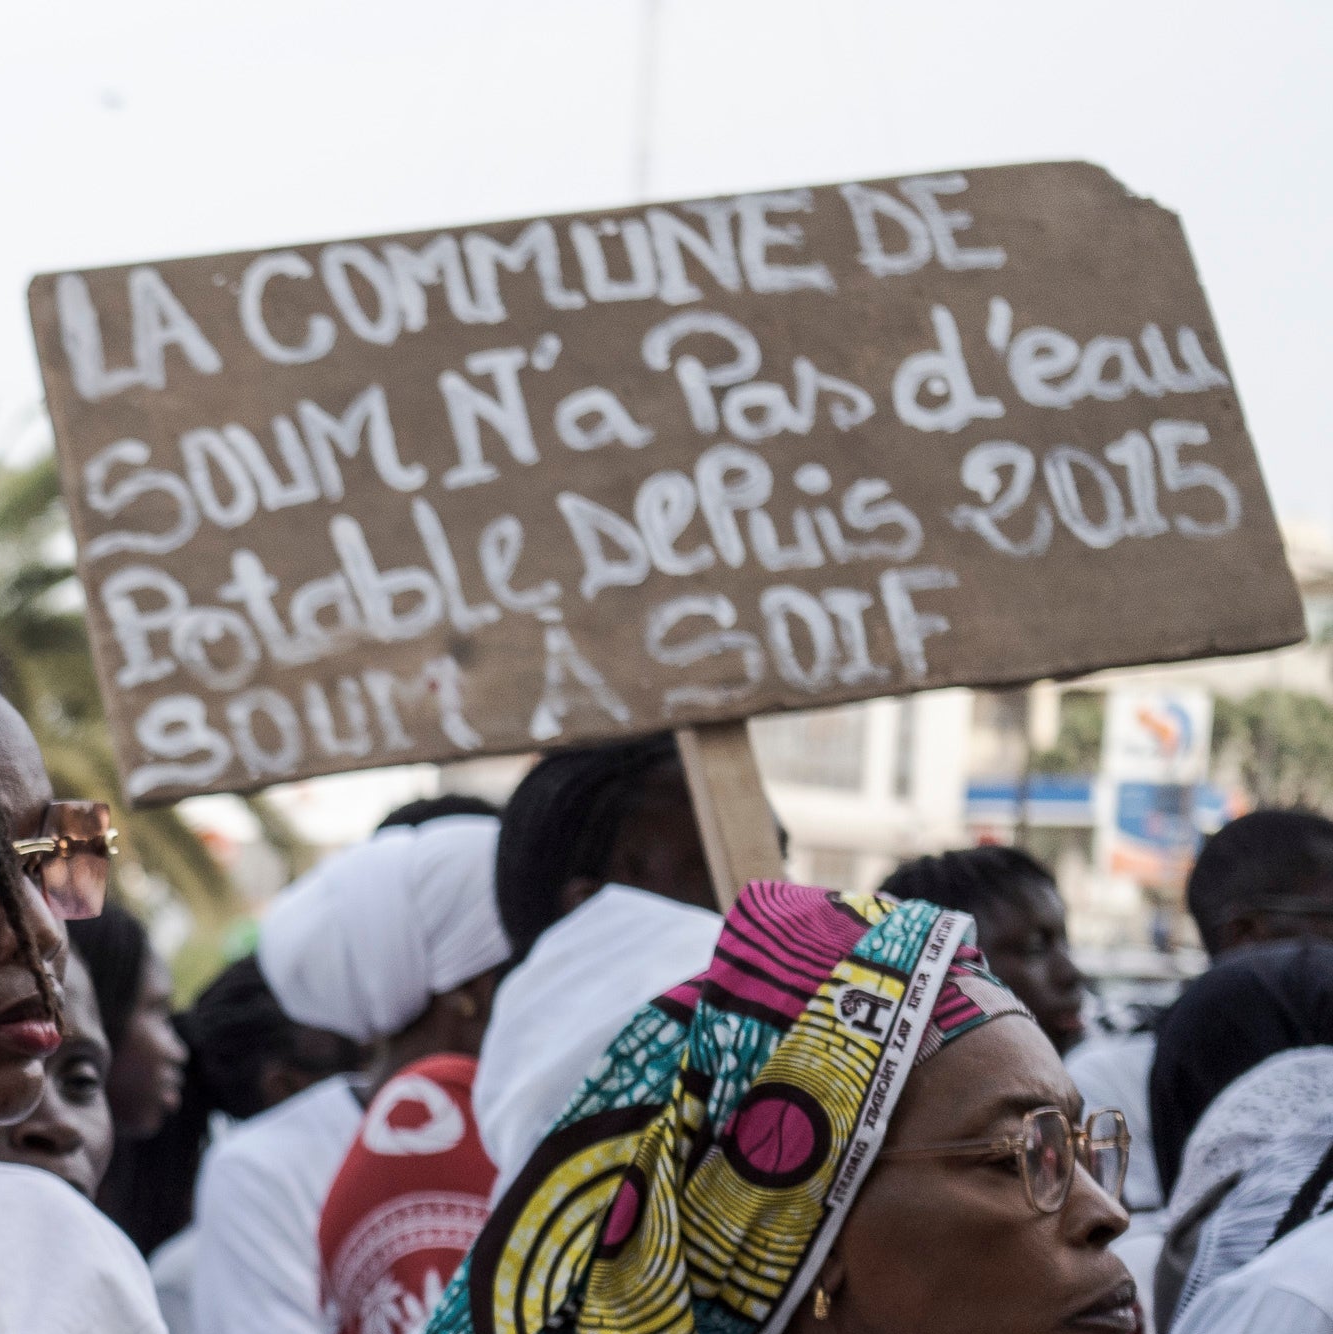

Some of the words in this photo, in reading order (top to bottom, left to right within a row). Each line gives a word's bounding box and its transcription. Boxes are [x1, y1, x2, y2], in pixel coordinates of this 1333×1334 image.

[56, 266, 222, 400] LA
[840, 173, 1007, 277] DE
[83, 384, 428, 559] SOUM
[642, 310, 875, 442] Pas
[892, 297, 1230, 432] d'eau
[99, 498, 563, 691] Potable
[950, 419, 1242, 557] 2015
[126, 656, 483, 798] SOUM
[644, 565, 958, 718] SOIF
